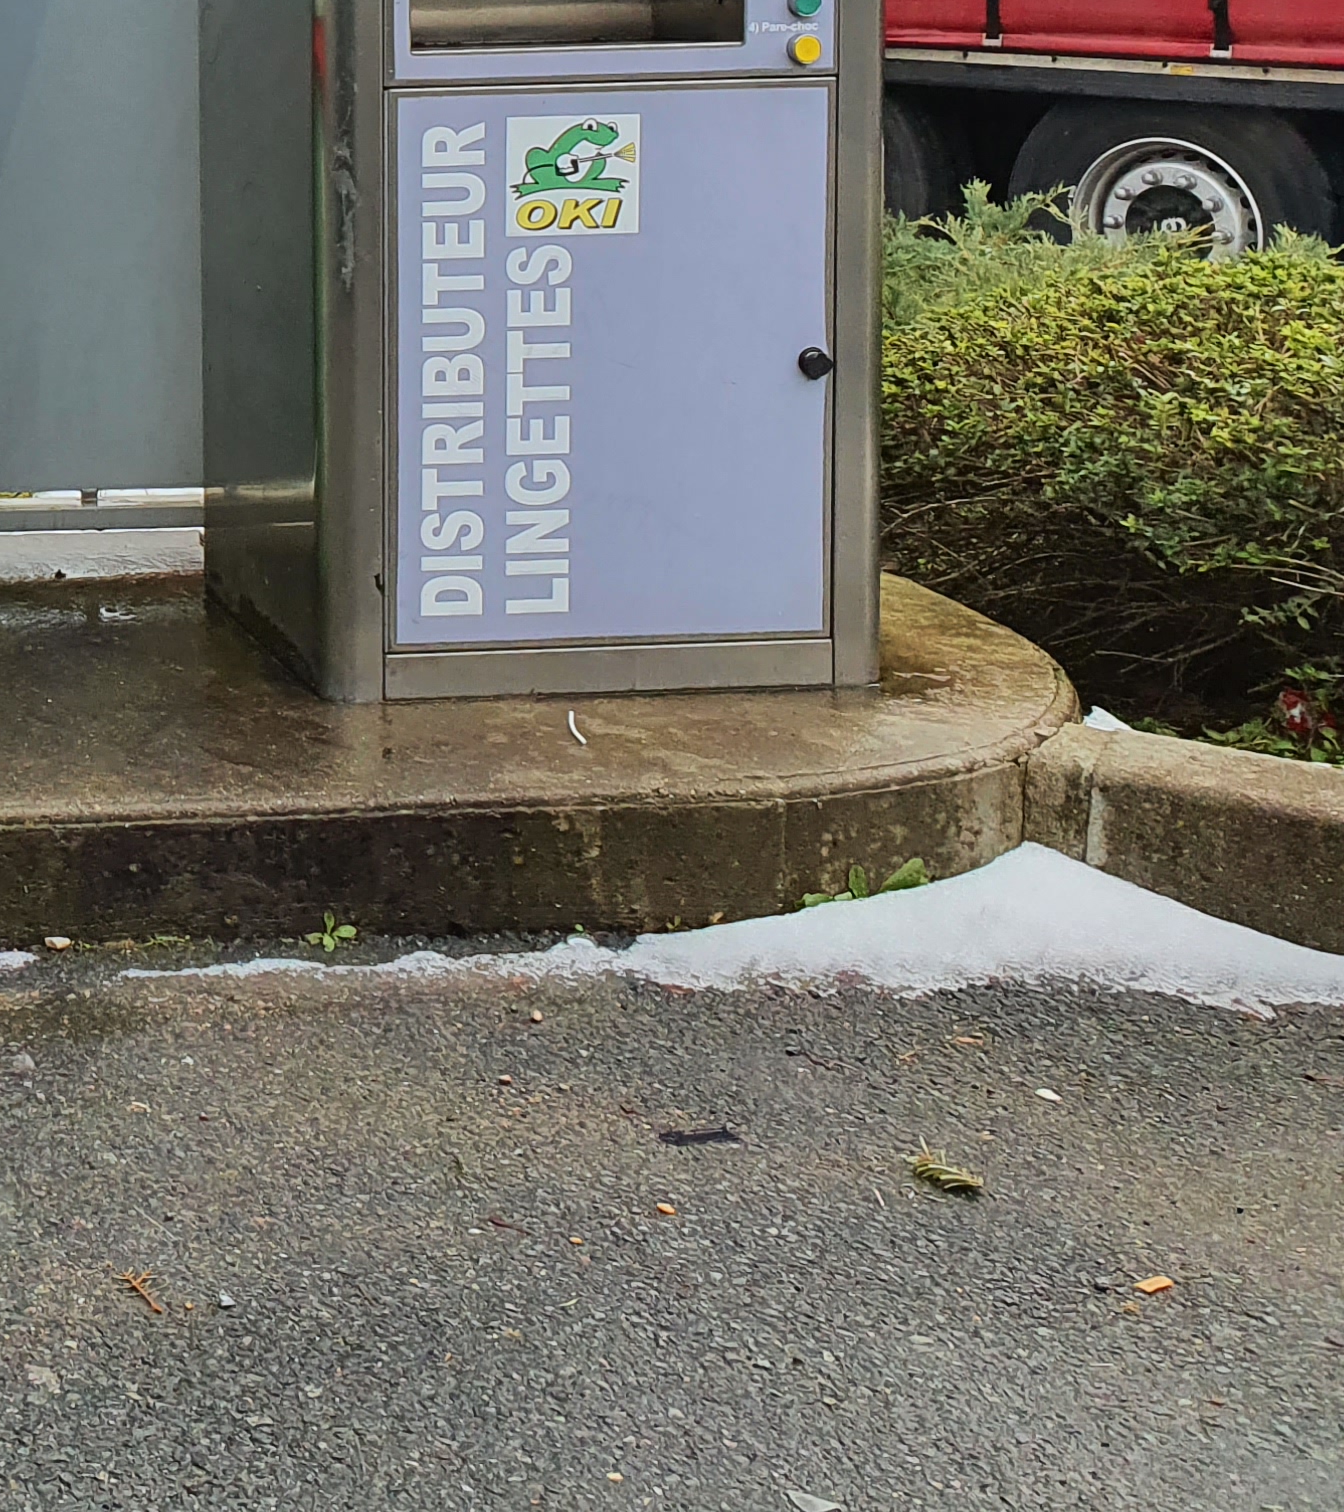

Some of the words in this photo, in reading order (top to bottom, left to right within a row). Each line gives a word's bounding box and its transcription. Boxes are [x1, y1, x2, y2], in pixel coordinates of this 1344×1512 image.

[420, 121, 487, 618] DISTRIBUTEUR
[515, 196, 624, 232] OKI
[505, 242, 573, 615] LINGETTES
